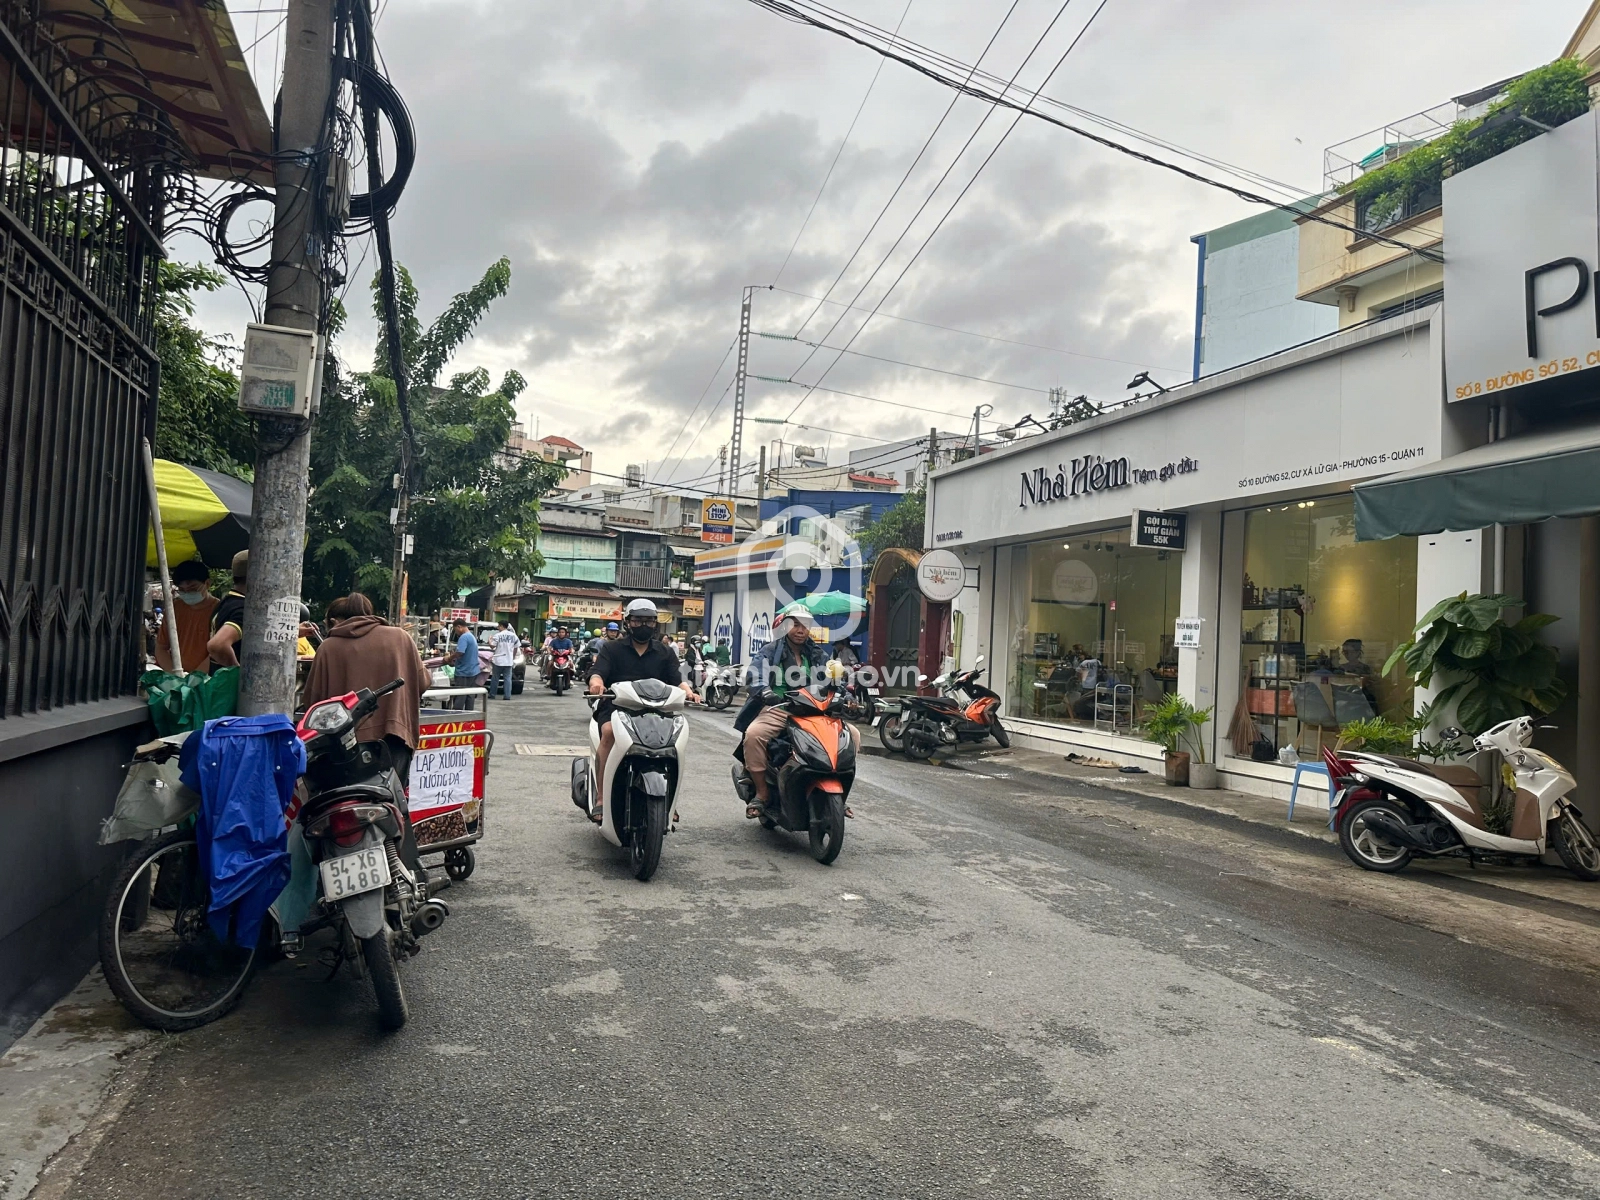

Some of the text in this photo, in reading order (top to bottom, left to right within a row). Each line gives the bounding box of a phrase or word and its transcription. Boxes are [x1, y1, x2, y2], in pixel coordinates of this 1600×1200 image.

[1525, 257, 1600, 359] P
[1456, 381, 1472, 399] SỐ
[1474, 382, 1482, 393] 8
[1486, 370, 1534, 392] ĐƯỜNG
[1538, 359, 1559, 377] SỐ
[1238, 477, 1248, 488] SỐ
[1248, 478, 1254, 487] 10
[1255, 473, 1280, 485] ĐƯỜNG
[1325, 463, 1339, 473] GIA
[1342, 456, 1378, 469] PHƯỜNG
[1378, 453, 1387, 463] 15
[1391, 448, 1415, 461] QUẬN
[1416, 446, 1424, 456] 11
[1020, 464, 1068, 507] Nhà
[1132, 469, 1157, 485] Tiệm
[1159, 462, 1177, 482] gội
[709, 533, 726, 542] 24H
[1153, 535, 1169, 544] 55K
[718, 624, 730, 637] MINI
[752, 638, 764, 652] STO
[434, 789, 455, 805] 15K
[333, 868, 381, 896] 3486
